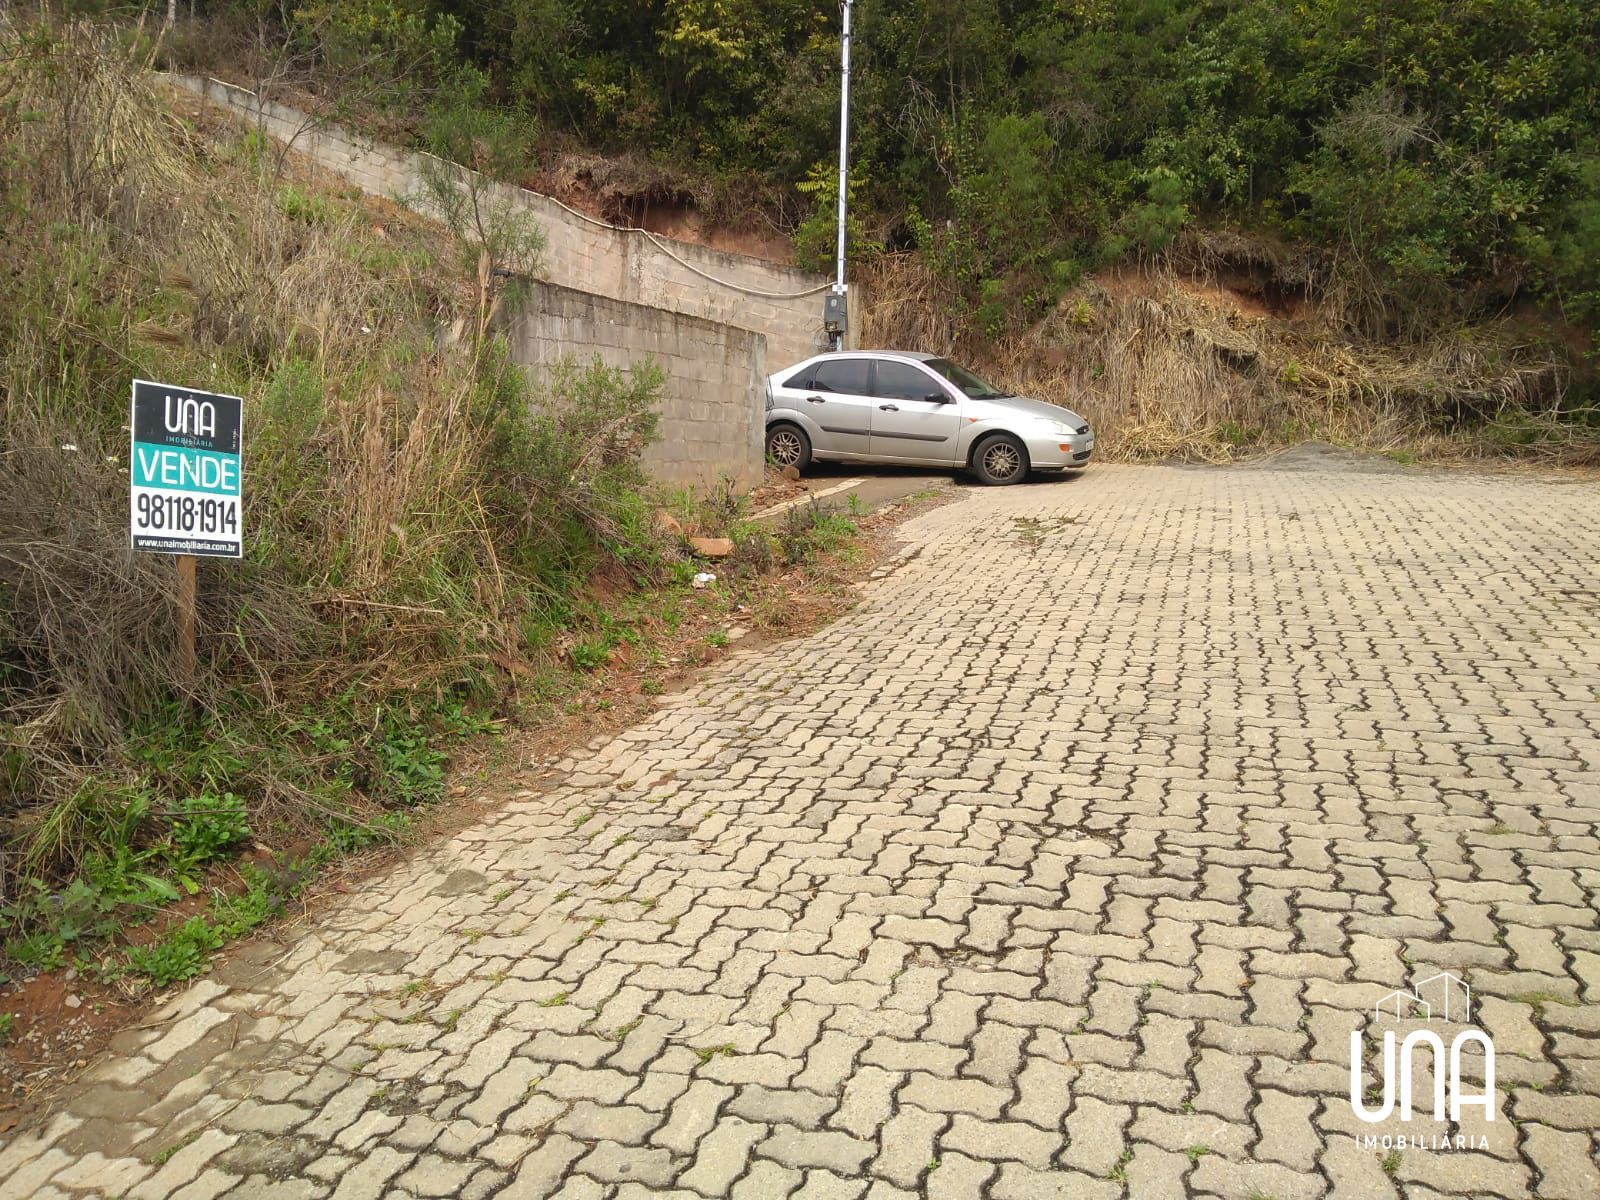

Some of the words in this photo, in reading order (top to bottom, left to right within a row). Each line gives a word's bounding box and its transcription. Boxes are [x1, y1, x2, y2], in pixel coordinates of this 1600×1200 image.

[165, 395, 215, 437] UNA
[138, 448, 236, 490] VENDE
[138, 493, 236, 534] 98118-1914
[138, 539, 236, 552] www.unaimobiliaria.com.br
